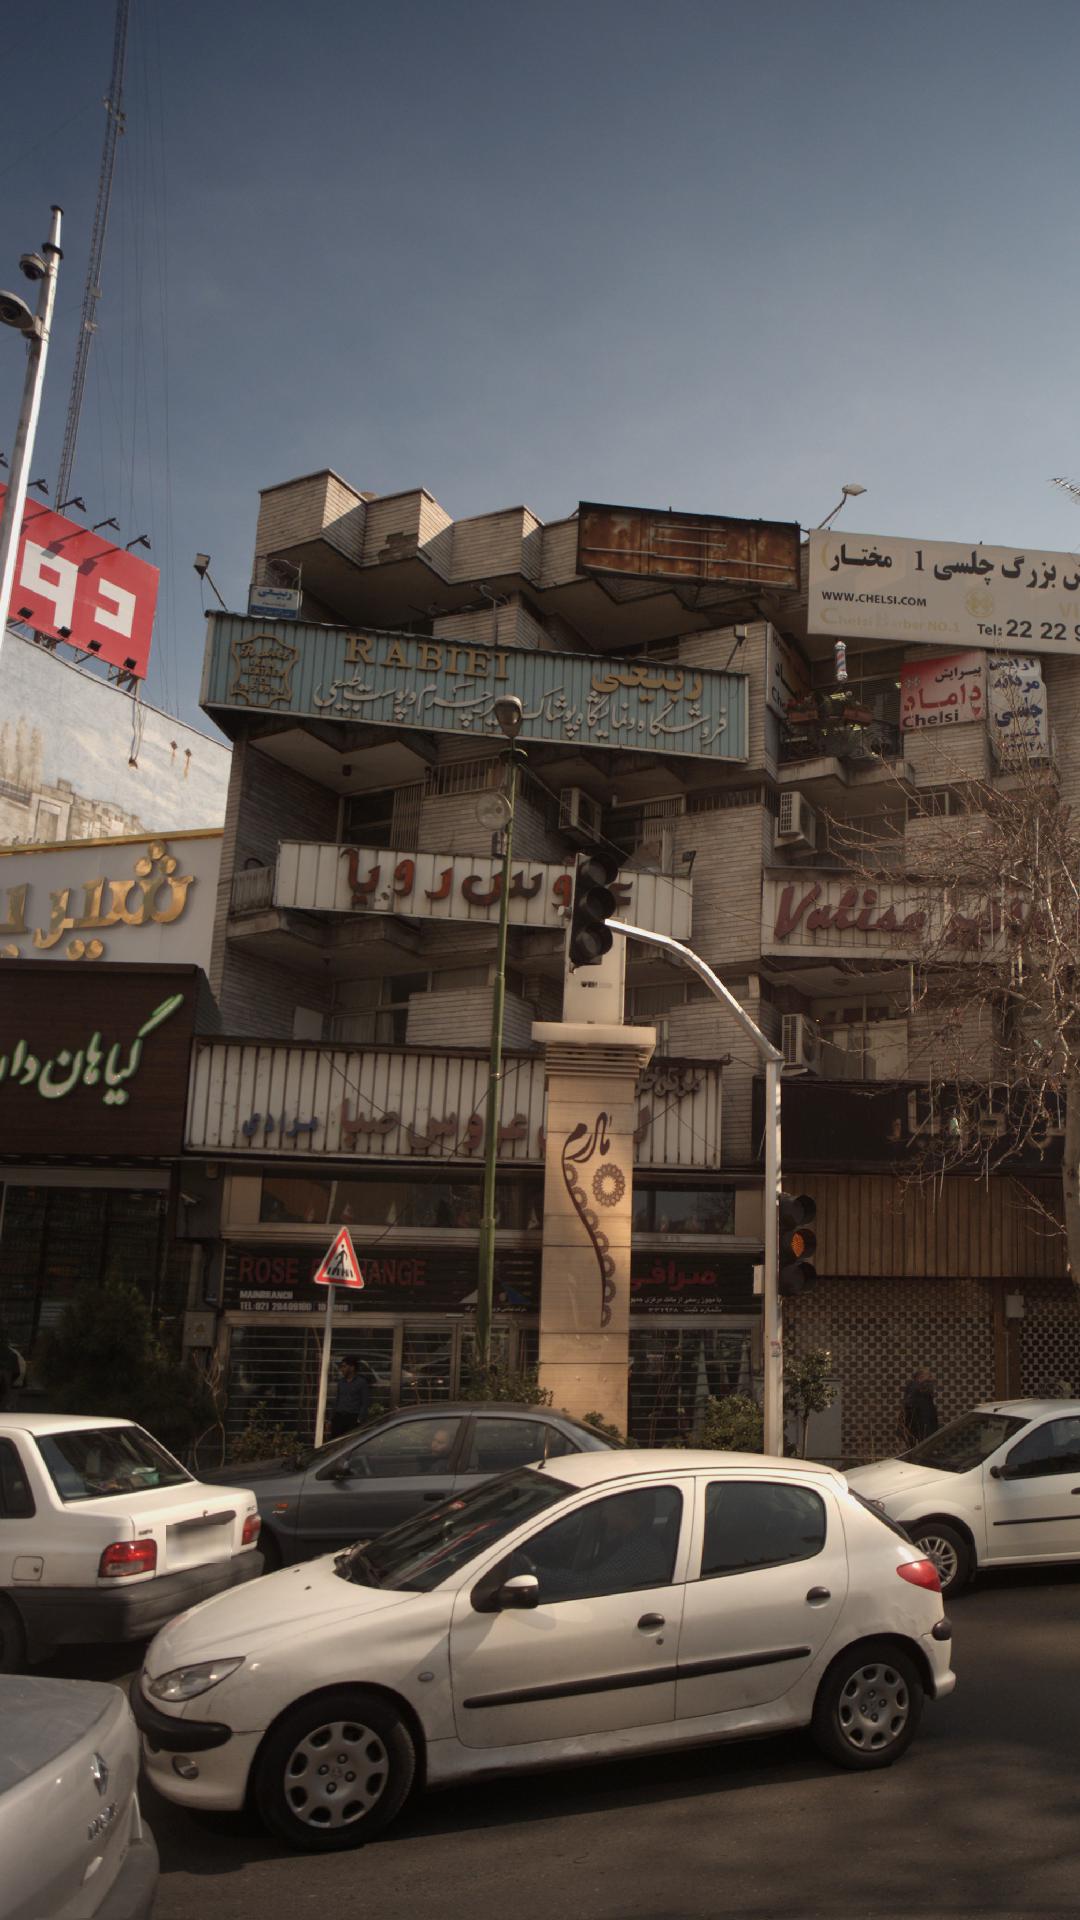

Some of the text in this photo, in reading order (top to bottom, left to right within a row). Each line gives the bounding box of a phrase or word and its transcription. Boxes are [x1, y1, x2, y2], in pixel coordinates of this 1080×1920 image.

[830, 544, 892, 571] مختار
[934, 551, 994, 586] چلسی
[1001, 556, 1057, 589] بزرگ
[821, 590, 927, 608] WWW.CHELSI.COM
[977, 624, 1003, 637] Tel:
[343, 633, 509, 681] RABIEI
[591, 667, 703, 702] ربیعی
[902, 710, 960, 729] Chelsi
[240, 1256, 299, 1284] ROSE
